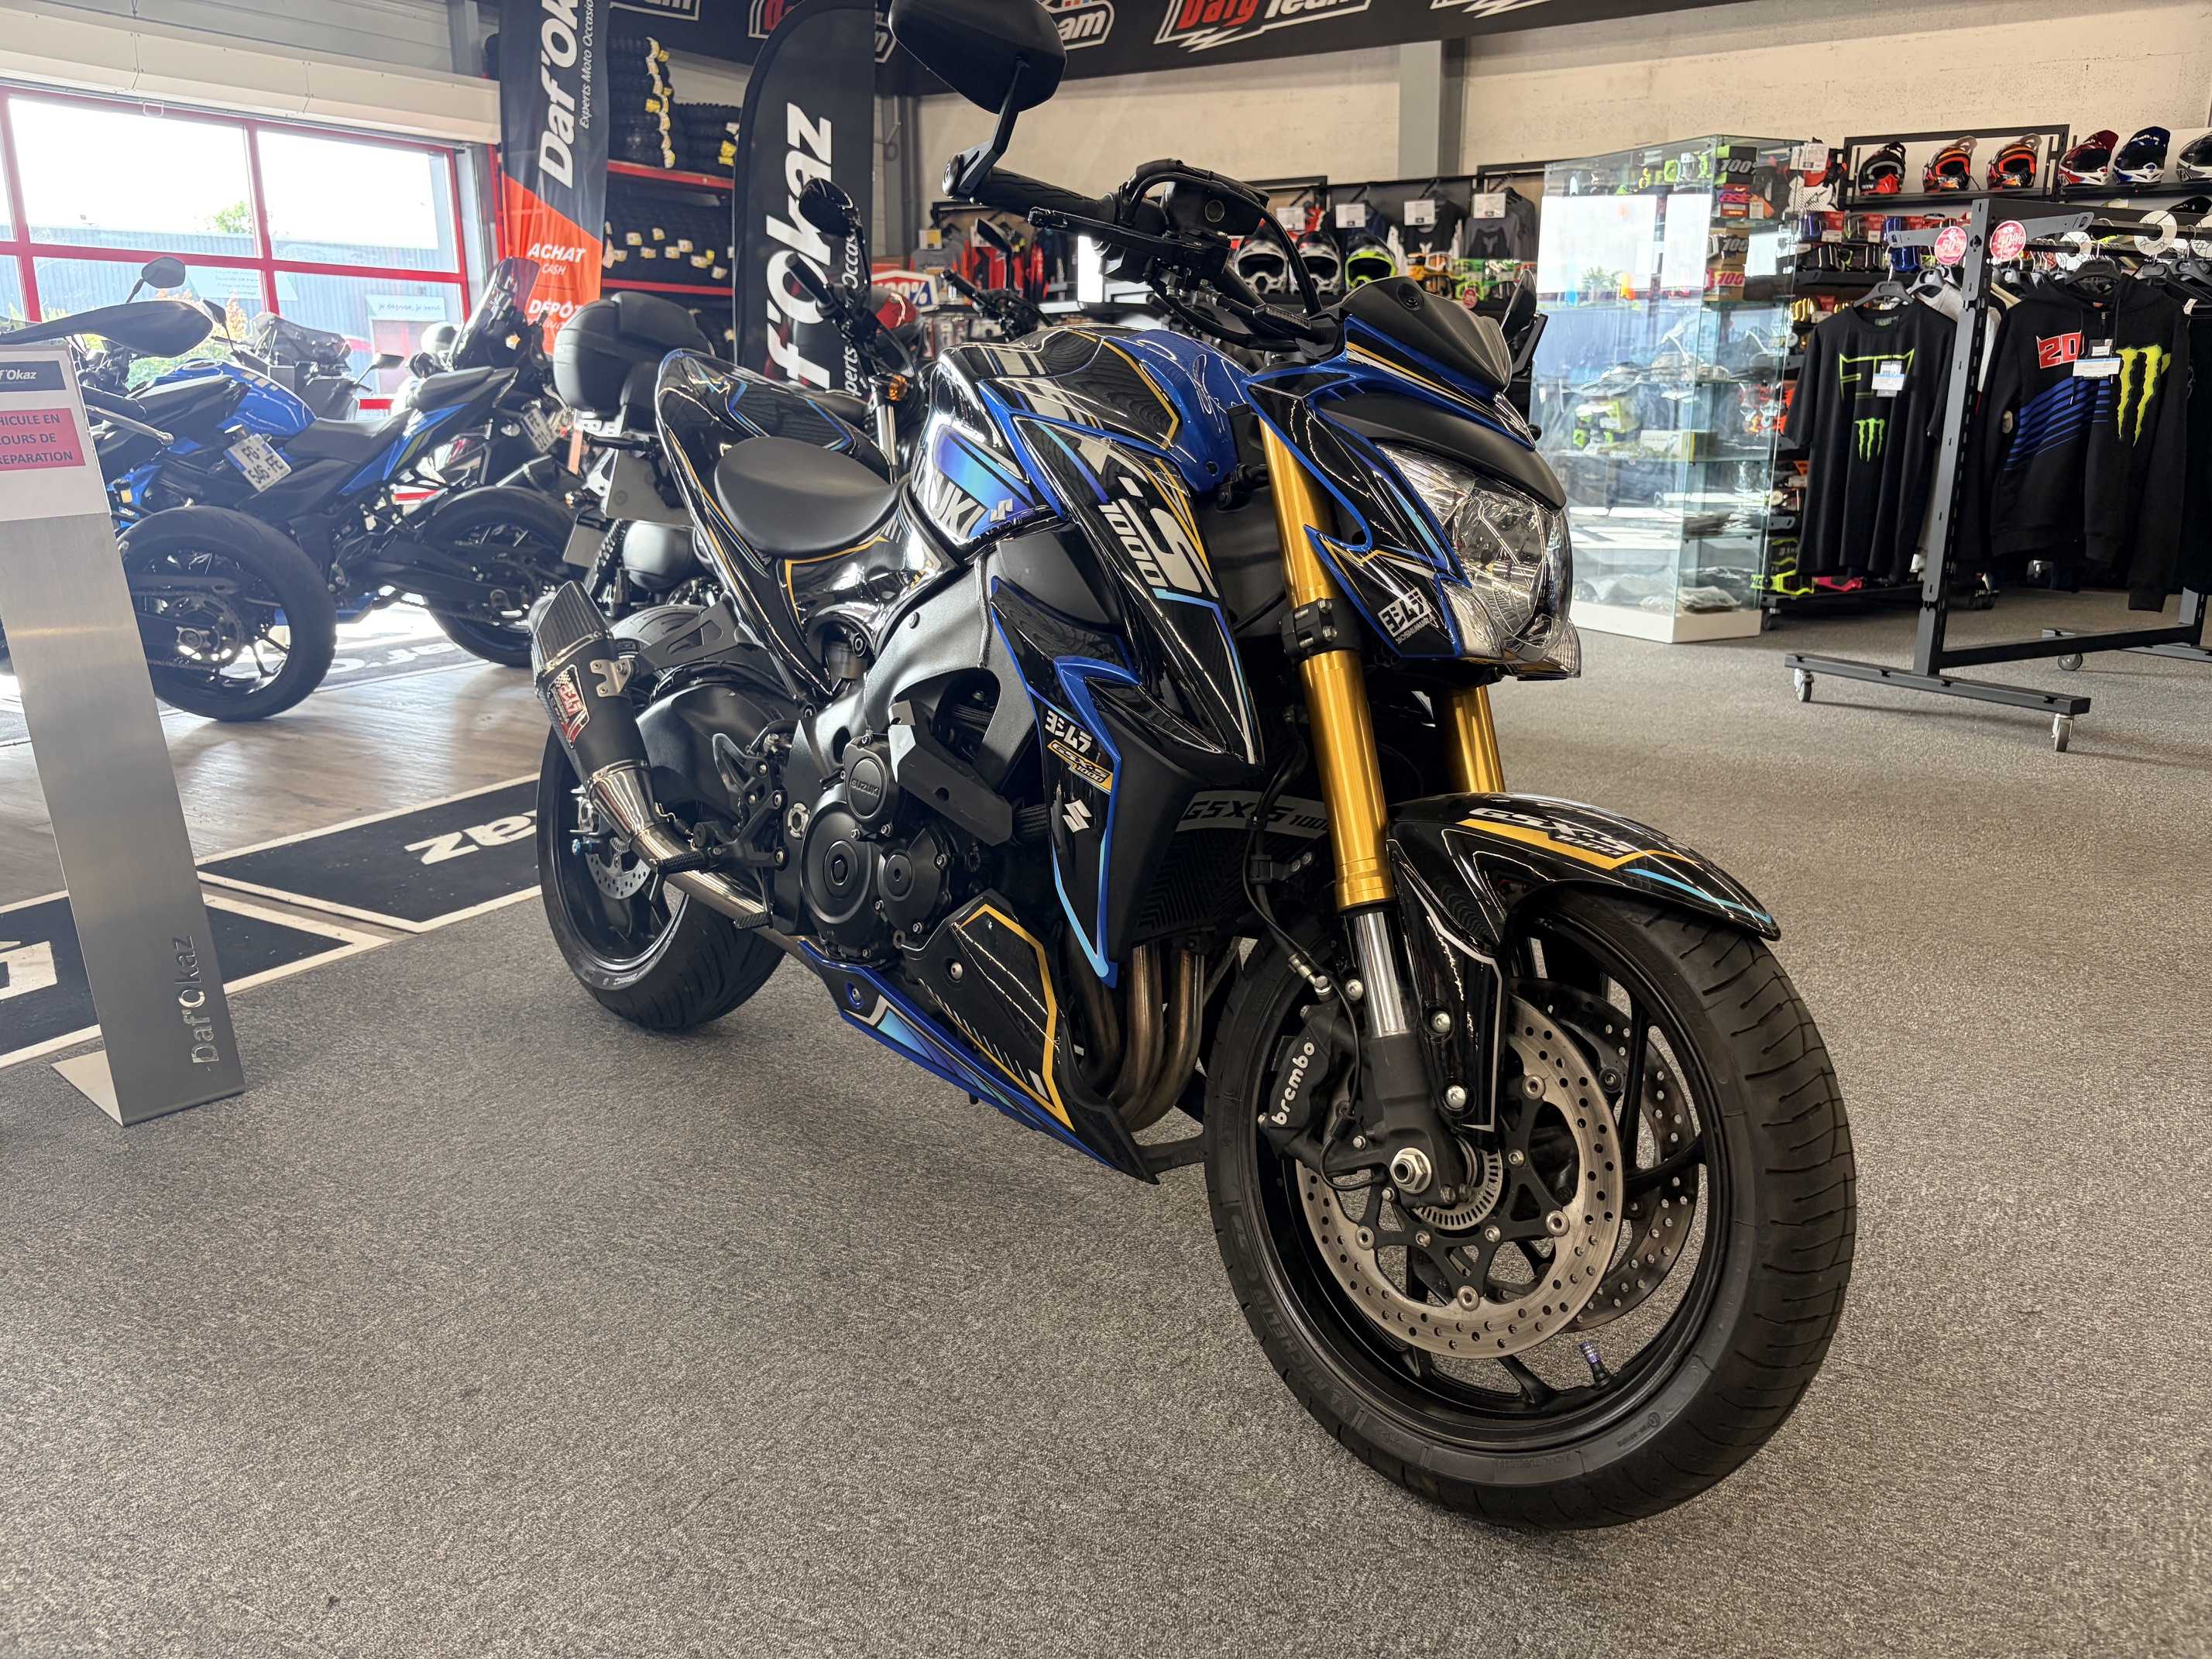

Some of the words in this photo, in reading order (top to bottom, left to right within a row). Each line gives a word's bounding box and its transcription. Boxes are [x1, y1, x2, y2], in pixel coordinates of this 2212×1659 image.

[527, 243, 587, 263] ACHAT
[542, 263, 568, 276] CASH
[2036, 330, 2082, 369] 20
[43, 414, 60, 424] EN
[0, 434, 37, 445] OURS
[40, 433, 57, 443] DE
[1097, 503, 1169, 588] 1000
[1052, 743, 1110, 778] GSX-S
[1076, 765, 1105, 783] 1000
[850, 778, 881, 798] SUZUKI
[1180, 799, 1295, 823] GSXS
[1469, 807, 1635, 852] GSX-S
[1554, 834, 1625, 856] 1000
[1271, 1042, 1315, 1125] brembo
